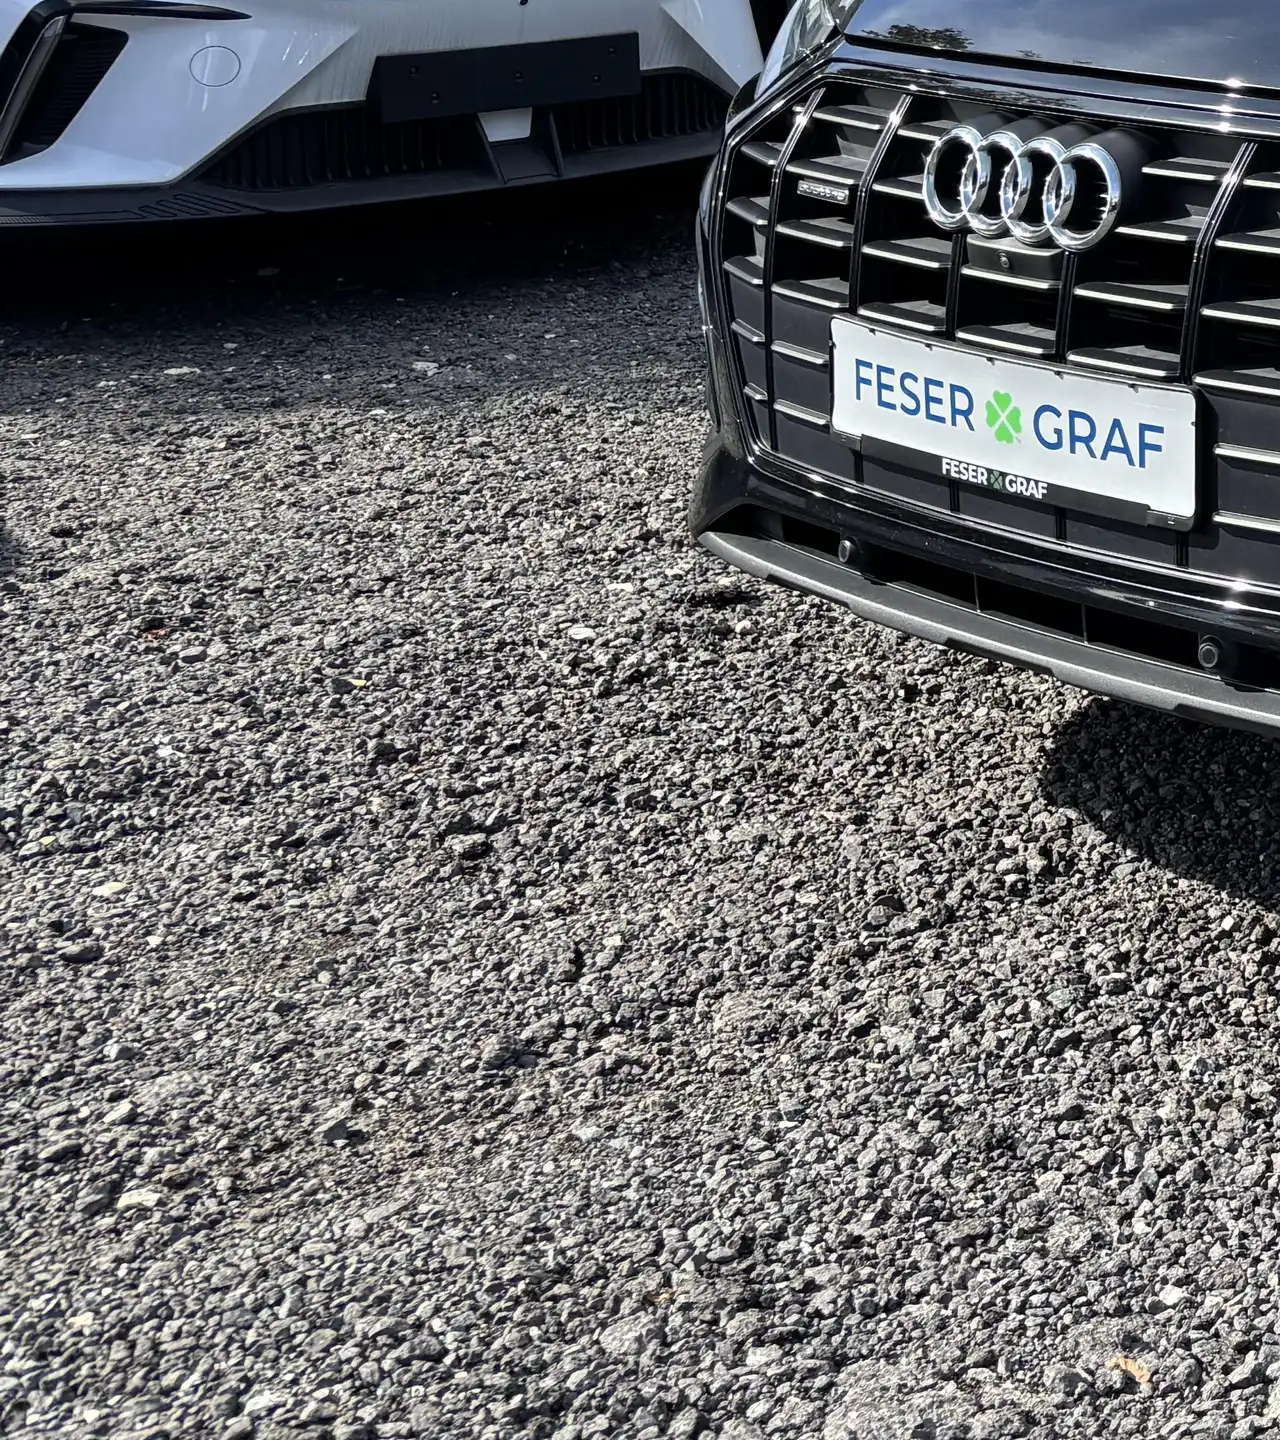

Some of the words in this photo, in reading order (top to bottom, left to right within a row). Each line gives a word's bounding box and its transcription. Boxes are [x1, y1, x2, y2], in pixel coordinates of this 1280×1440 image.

[855, 358, 975, 431] FESER
[1033, 404, 1165, 468] GRAF
[941, 457, 988, 486] FESER
[1005, 474, 1048, 499] GRAF
